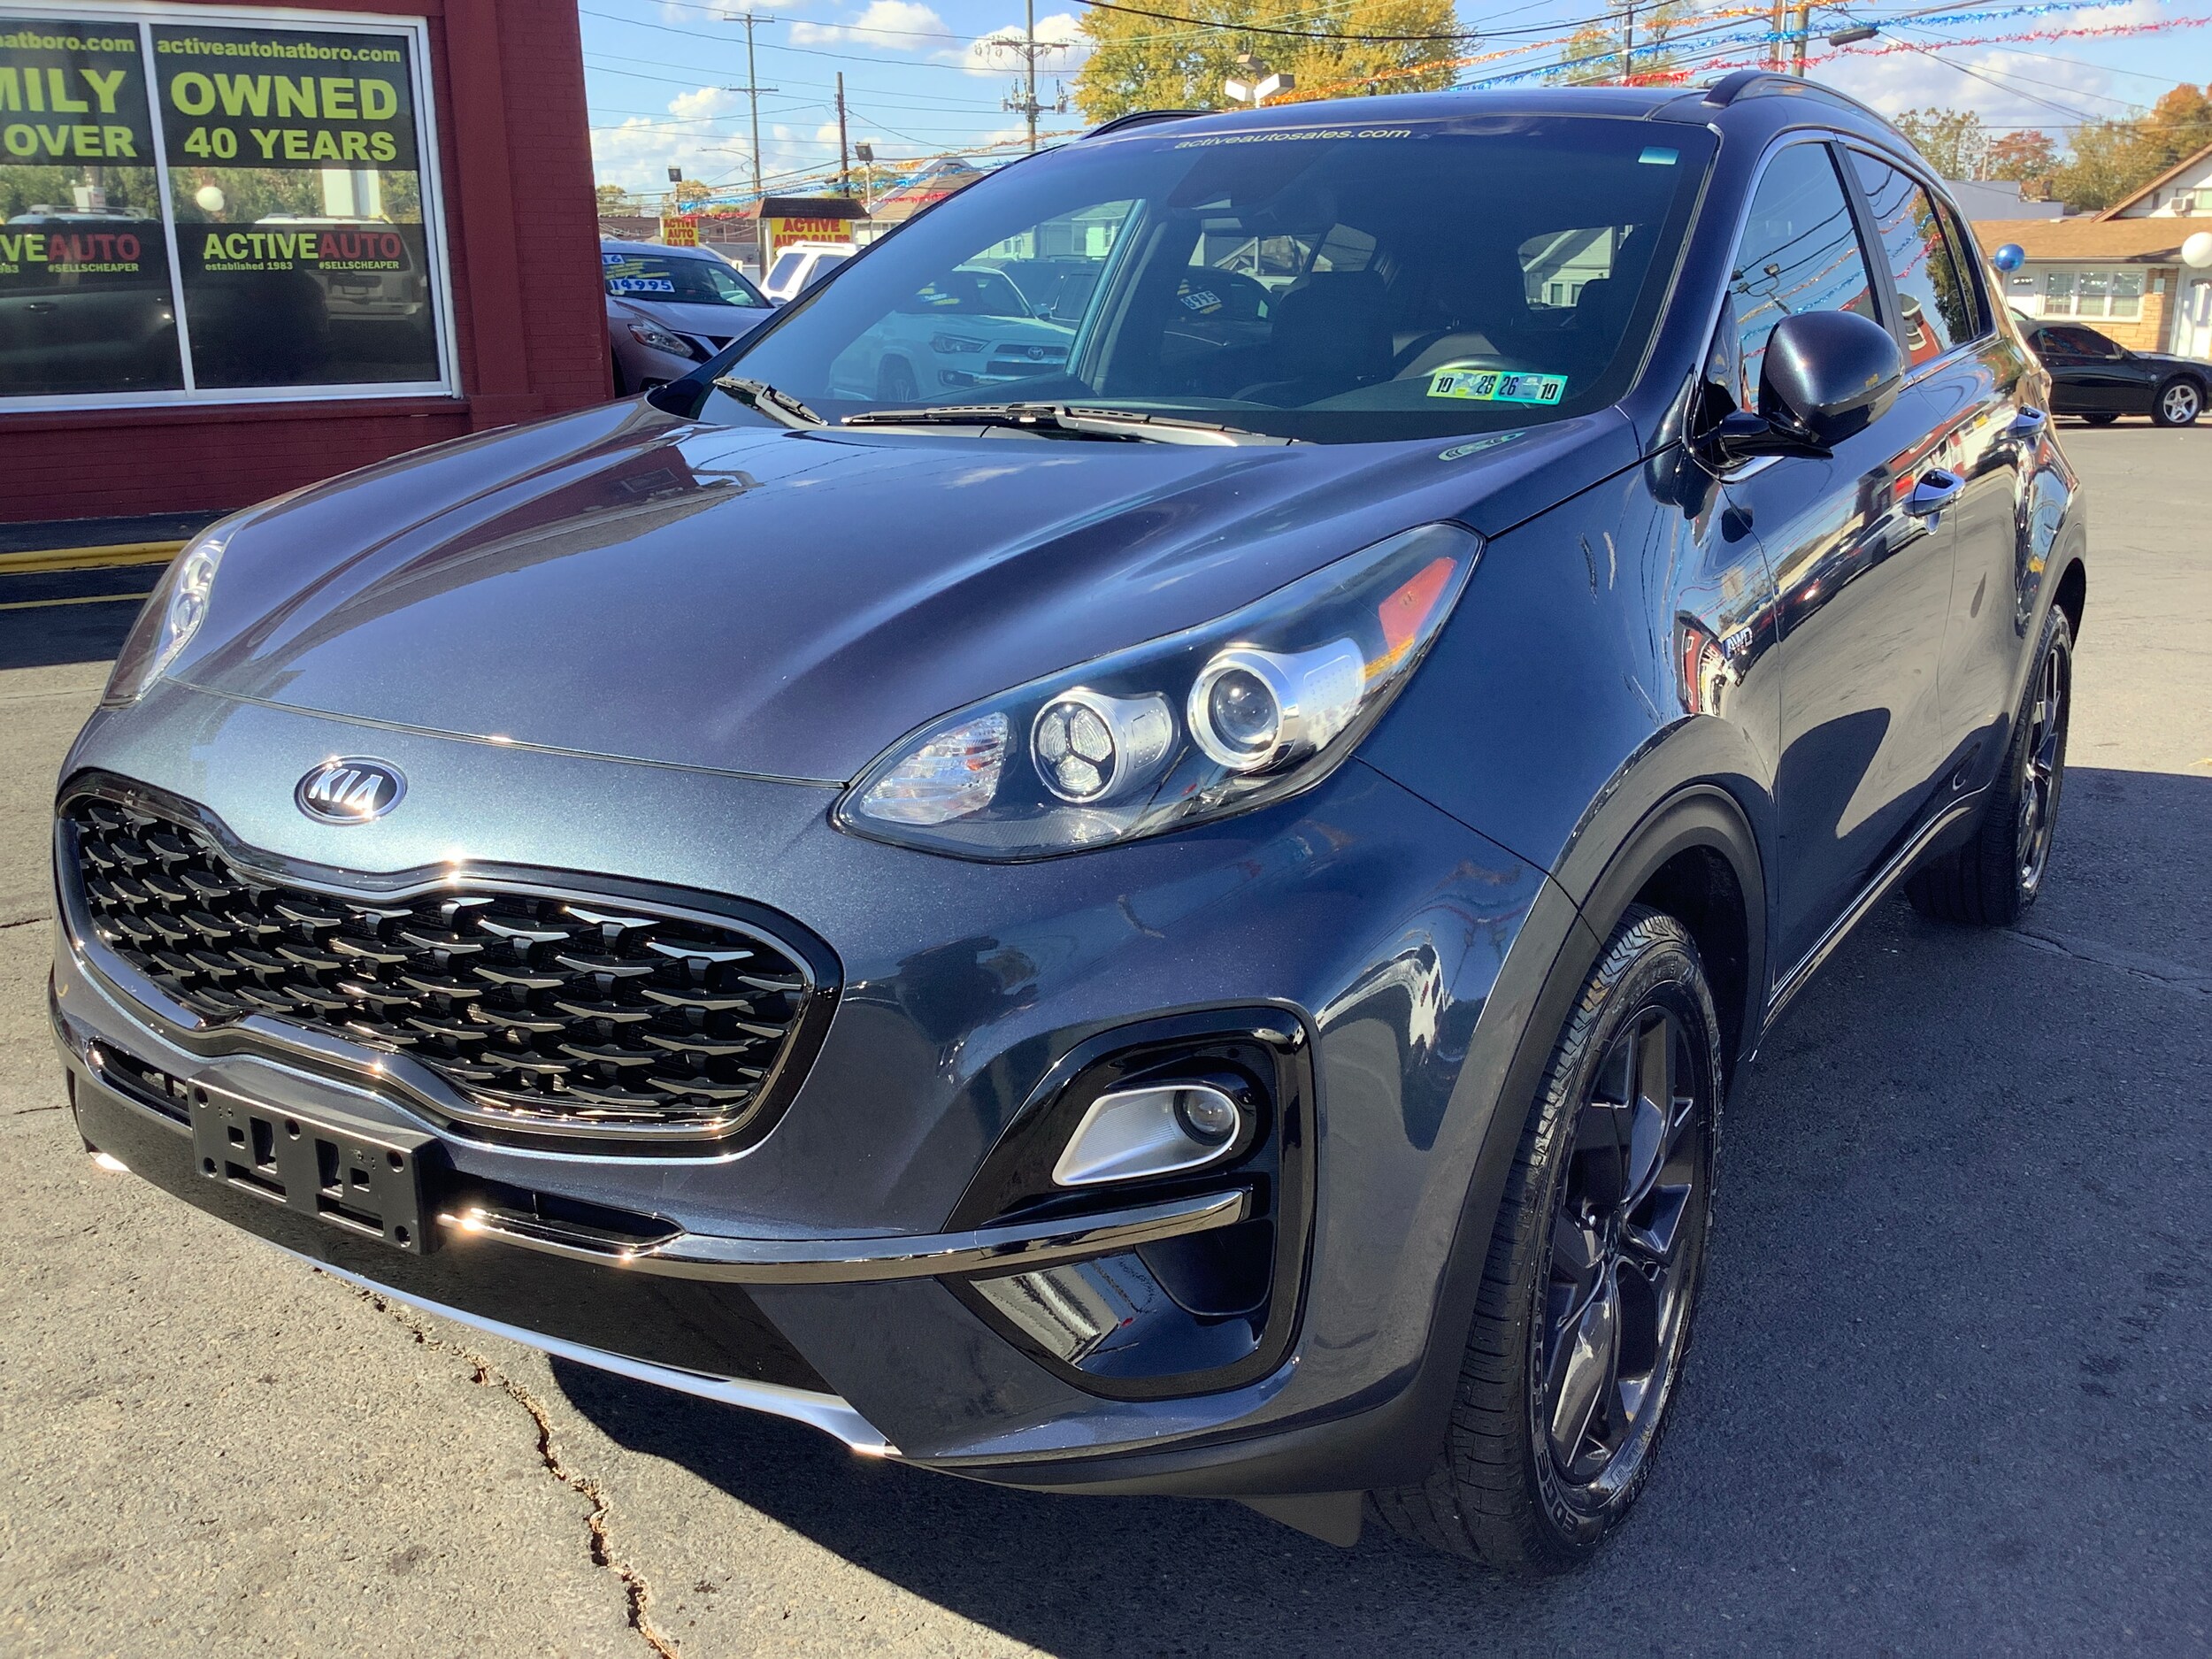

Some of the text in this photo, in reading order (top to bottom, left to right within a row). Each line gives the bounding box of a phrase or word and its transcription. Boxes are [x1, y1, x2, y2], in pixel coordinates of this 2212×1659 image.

[0, 31, 135, 52] atboro.com
[157, 37, 401, 62] activeautohatboro.com
[171, 72, 397, 119] OWNED
[4, 124, 138, 157] OVER
[184, 127, 397, 161] 40 YEARS
[1175, 128, 1411, 149] activeautosales.com
[664, 219, 697, 228] ACTIVE
[668, 228, 694, 238] AUTO
[782, 218, 841, 233] ACTIVE
[48, 263, 140, 273] #SELLSCHEAPER
[205, 261, 294, 271] established 1983
[319, 260, 400, 270] #SELLSCHEAPER
[612, 279, 672, 291] 14995
[1499, 375, 1520, 396] 26
[1726, 626, 1753, 659] AWD
[308, 767, 384, 810] KIA
